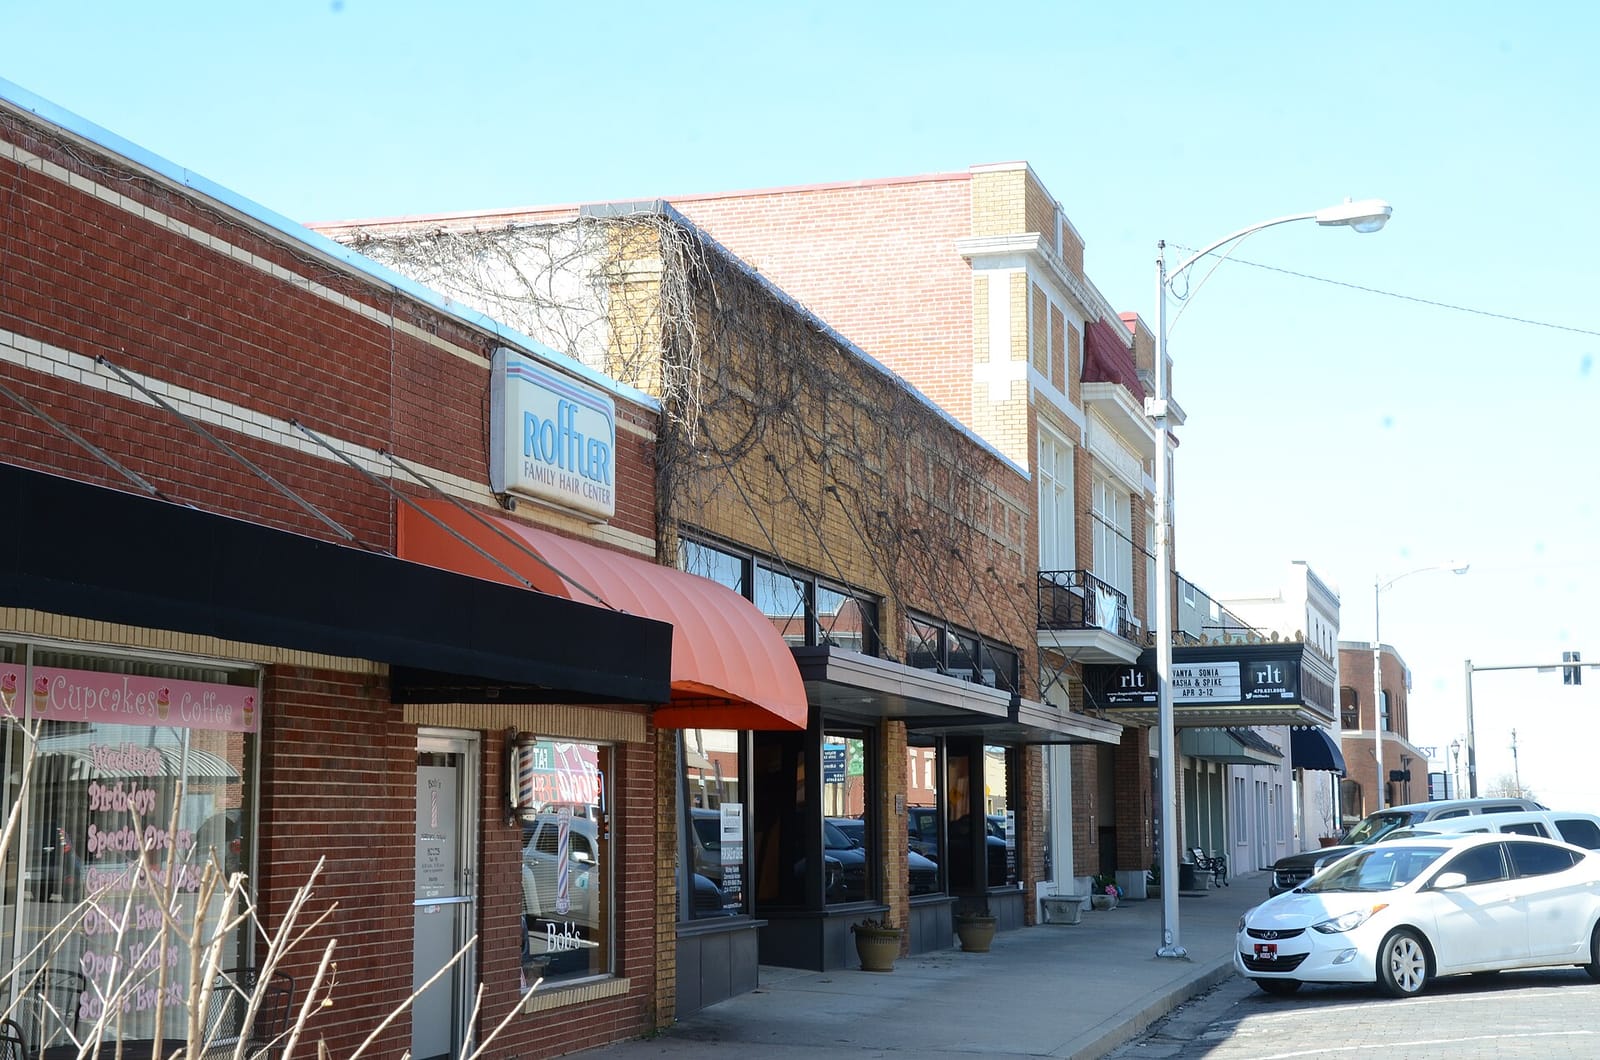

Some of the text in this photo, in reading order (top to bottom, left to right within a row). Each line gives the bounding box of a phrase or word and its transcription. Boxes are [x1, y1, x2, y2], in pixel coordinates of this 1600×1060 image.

[524, 462, 611, 506] FAMILY HAIR CENTER
[1120, 669, 1144, 687] rlt
[1194, 678, 1200, 687] &
[1202, 678, 1222, 687] SPIKE
[1198, 668, 1219, 677] SONIA
[1256, 664, 1282, 684] rlt
[51, 675, 233, 723] Cupcakes Coffee
[1182, 688, 1214, 697] APR 3-12
[89, 742, 161, 777] Weddings
[88, 781, 156, 816] Birthdays
[545, 920, 581, 953] Bob's
